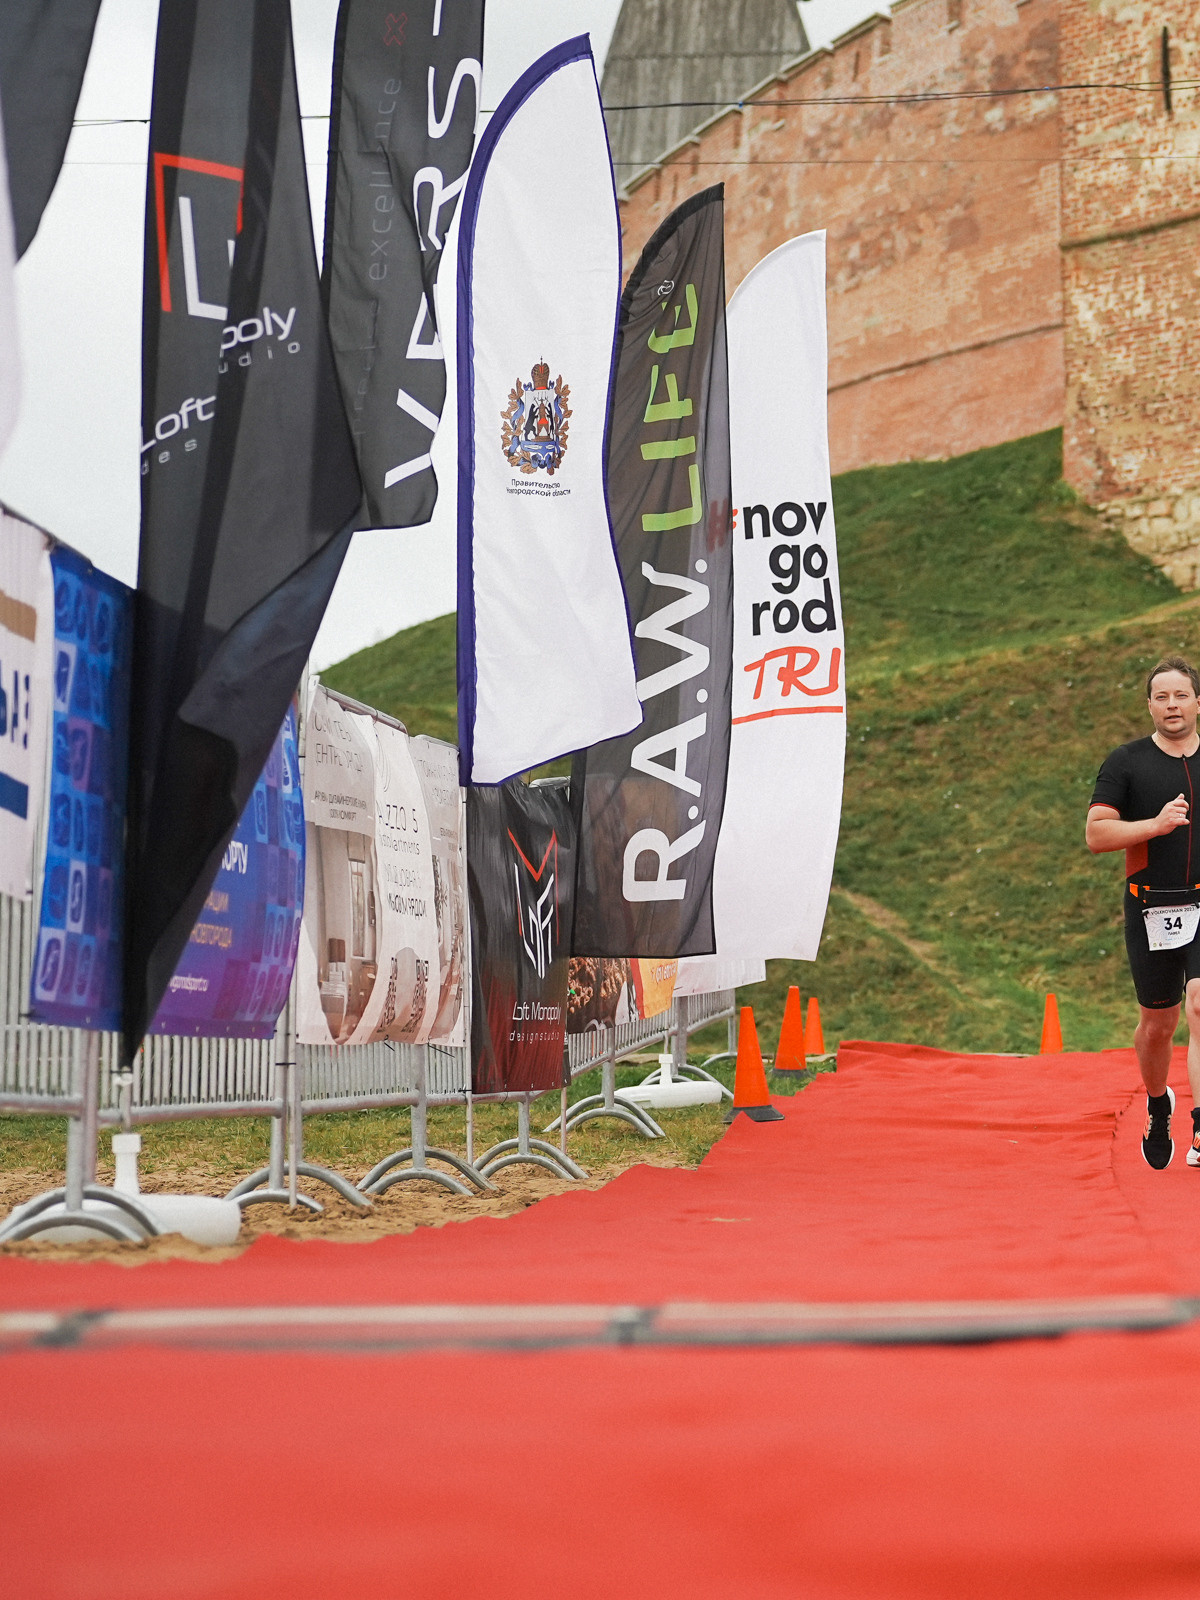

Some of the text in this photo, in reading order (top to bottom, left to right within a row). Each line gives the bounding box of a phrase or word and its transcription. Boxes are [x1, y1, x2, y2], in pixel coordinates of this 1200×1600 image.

[768, 543, 829, 595] go
[751, 578, 838, 637] rod
[743, 645, 842, 701] TRI
[411, 808, 419, 834] 5
[1163, 916, 1183, 931] 34
